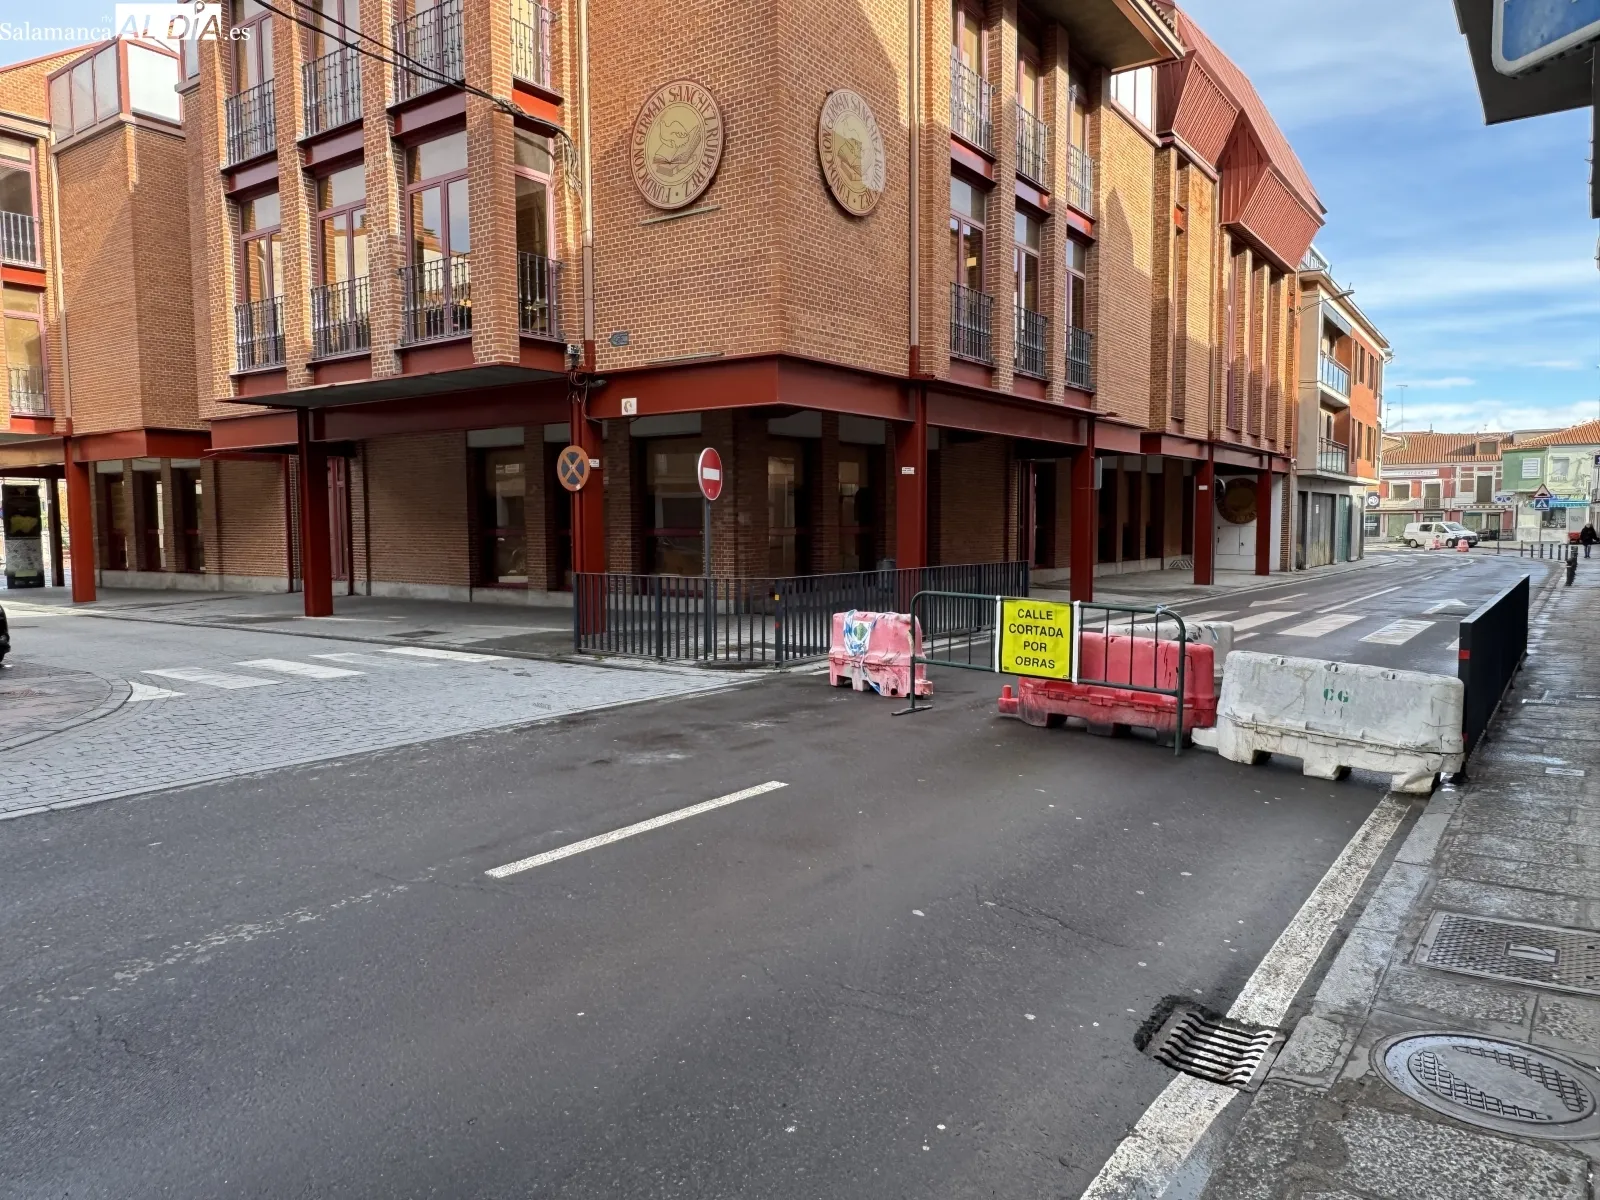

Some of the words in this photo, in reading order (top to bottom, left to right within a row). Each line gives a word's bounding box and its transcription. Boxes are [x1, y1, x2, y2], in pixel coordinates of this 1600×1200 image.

[669, 86, 717, 126] SANCHEZ
[635, 93, 667, 146] GERMAN
[634, 148, 671, 204] FUNDACION
[1017, 608, 1053, 620] CALLE
[1008, 623, 1064, 638] CORTADA
[1023, 640, 1047, 652] POR
[1015, 656, 1055, 669] OBRAS
